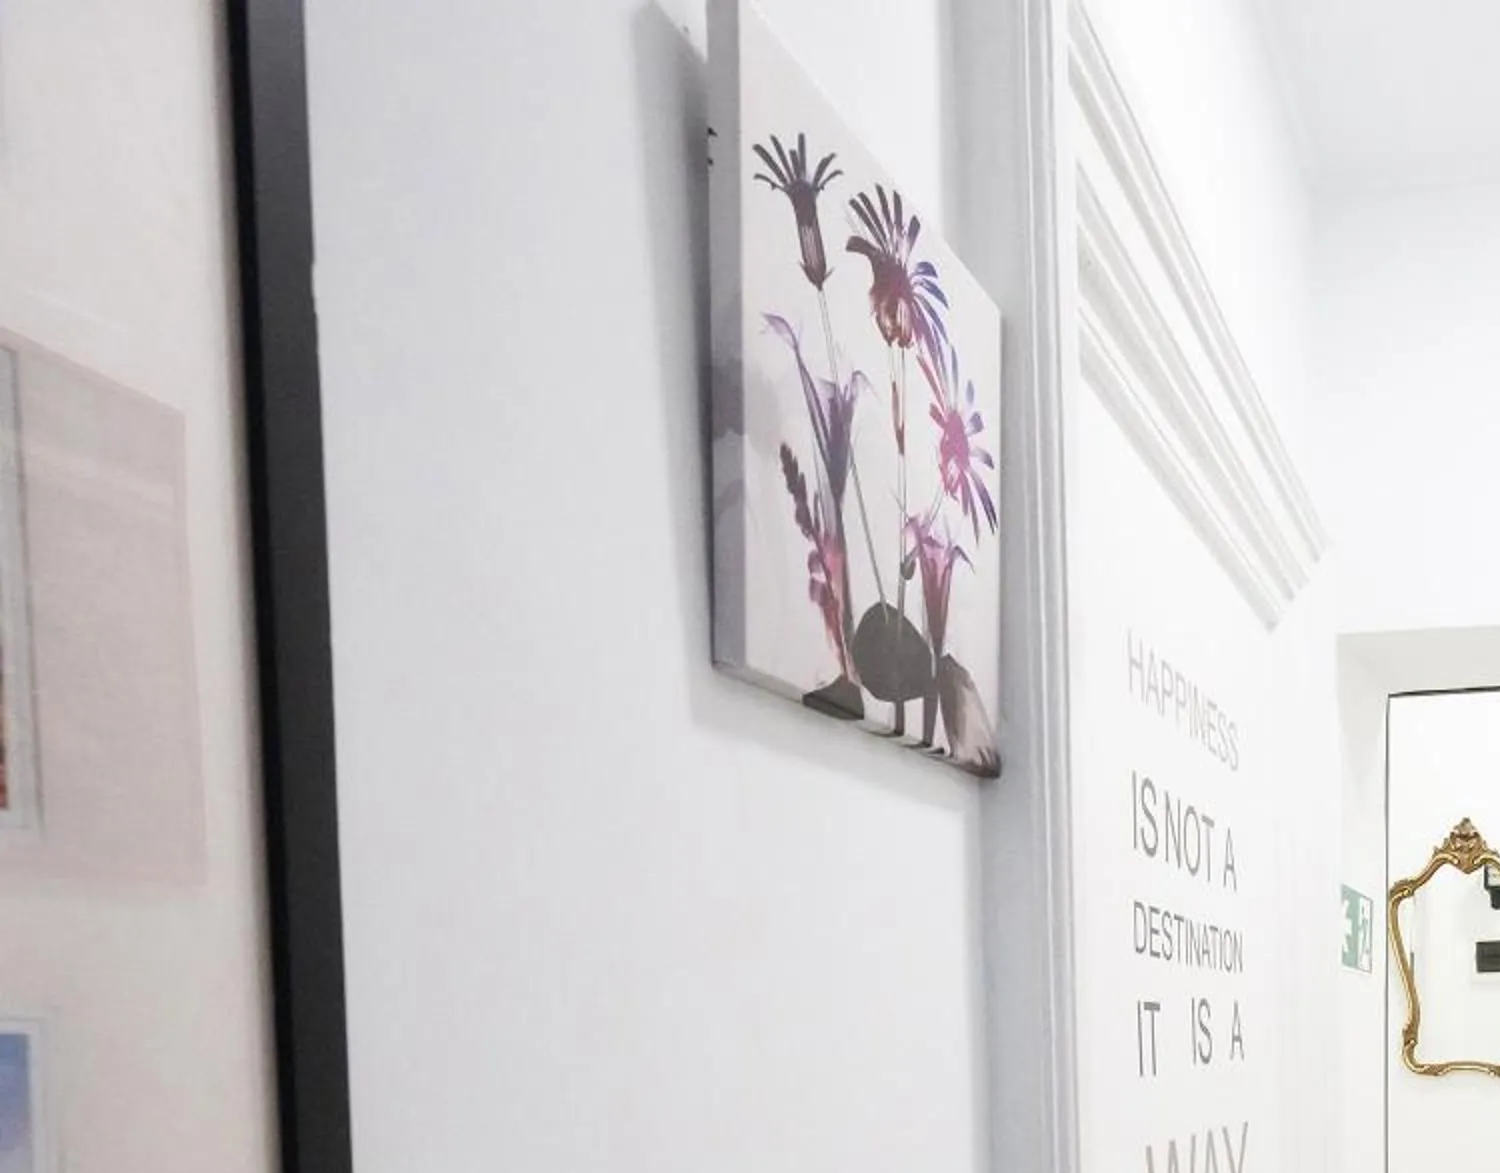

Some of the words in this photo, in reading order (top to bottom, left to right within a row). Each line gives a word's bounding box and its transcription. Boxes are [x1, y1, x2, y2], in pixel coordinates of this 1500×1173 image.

[1127, 627, 1239, 772] HAPPINESS
[1131, 769, 1159, 858] IS
[1164, 791, 1215, 882] NOT
[1223, 828, 1237, 892] A
[1133, 901, 1243, 973] DESTINATION
[1137, 1000, 1160, 1077] IT
[1191, 998, 1213, 1066] IS
[1230, 1001, 1245, 1061] A
